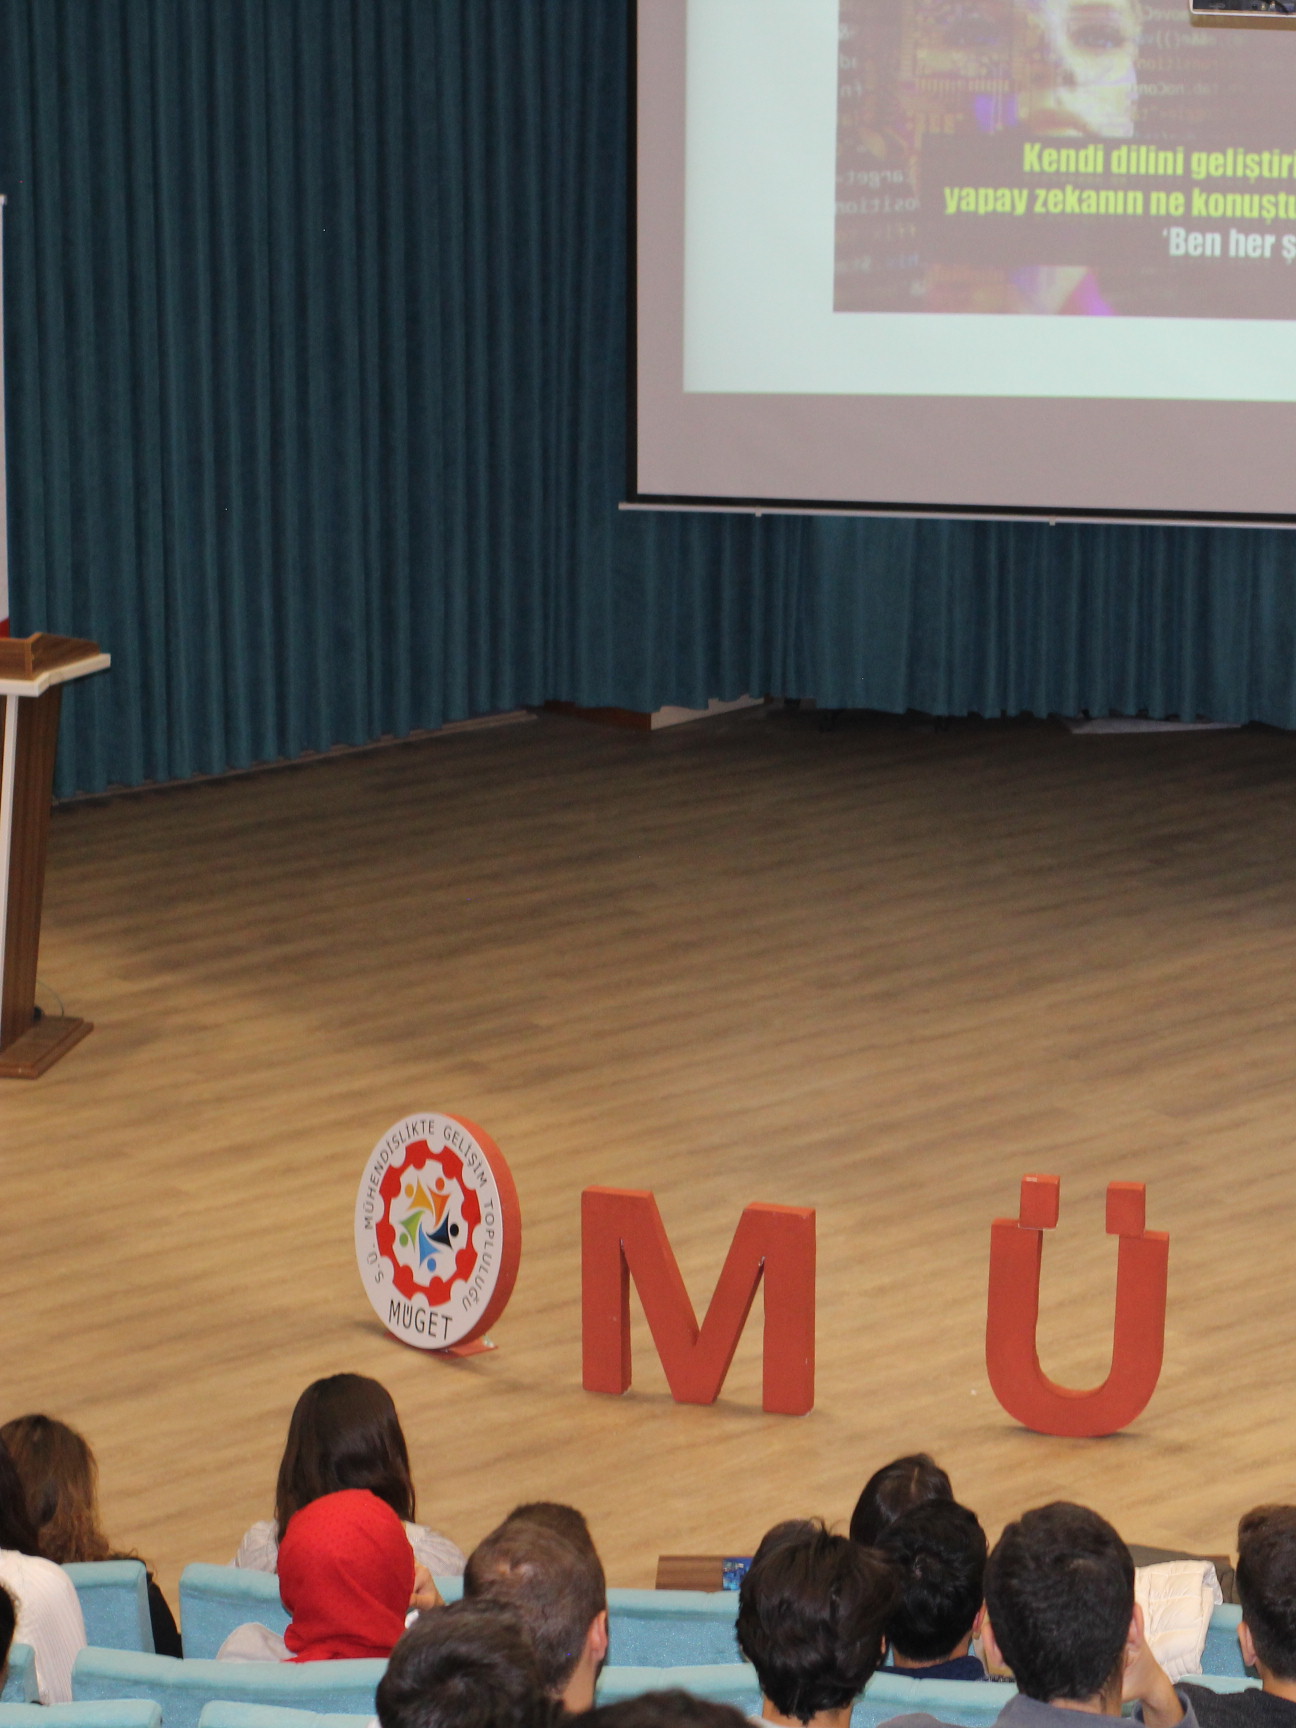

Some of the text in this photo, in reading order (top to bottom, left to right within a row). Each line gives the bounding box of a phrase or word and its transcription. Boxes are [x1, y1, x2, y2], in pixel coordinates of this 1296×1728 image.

[1023, 143, 1104, 174] Kendi
[1111, 144, 1184, 176] dilini
[944, 186, 1028, 216] yapay
[1034, 184, 1143, 215] zekanın
[1150, 191, 1185, 216] ne
[1229, 228, 1276, 259] her
[443, 1125, 488, 1188] GELİŞİM
[461, 1197, 495, 1312] TOPLULUĞU
[388, 1299, 453, 1341] MÜGET
